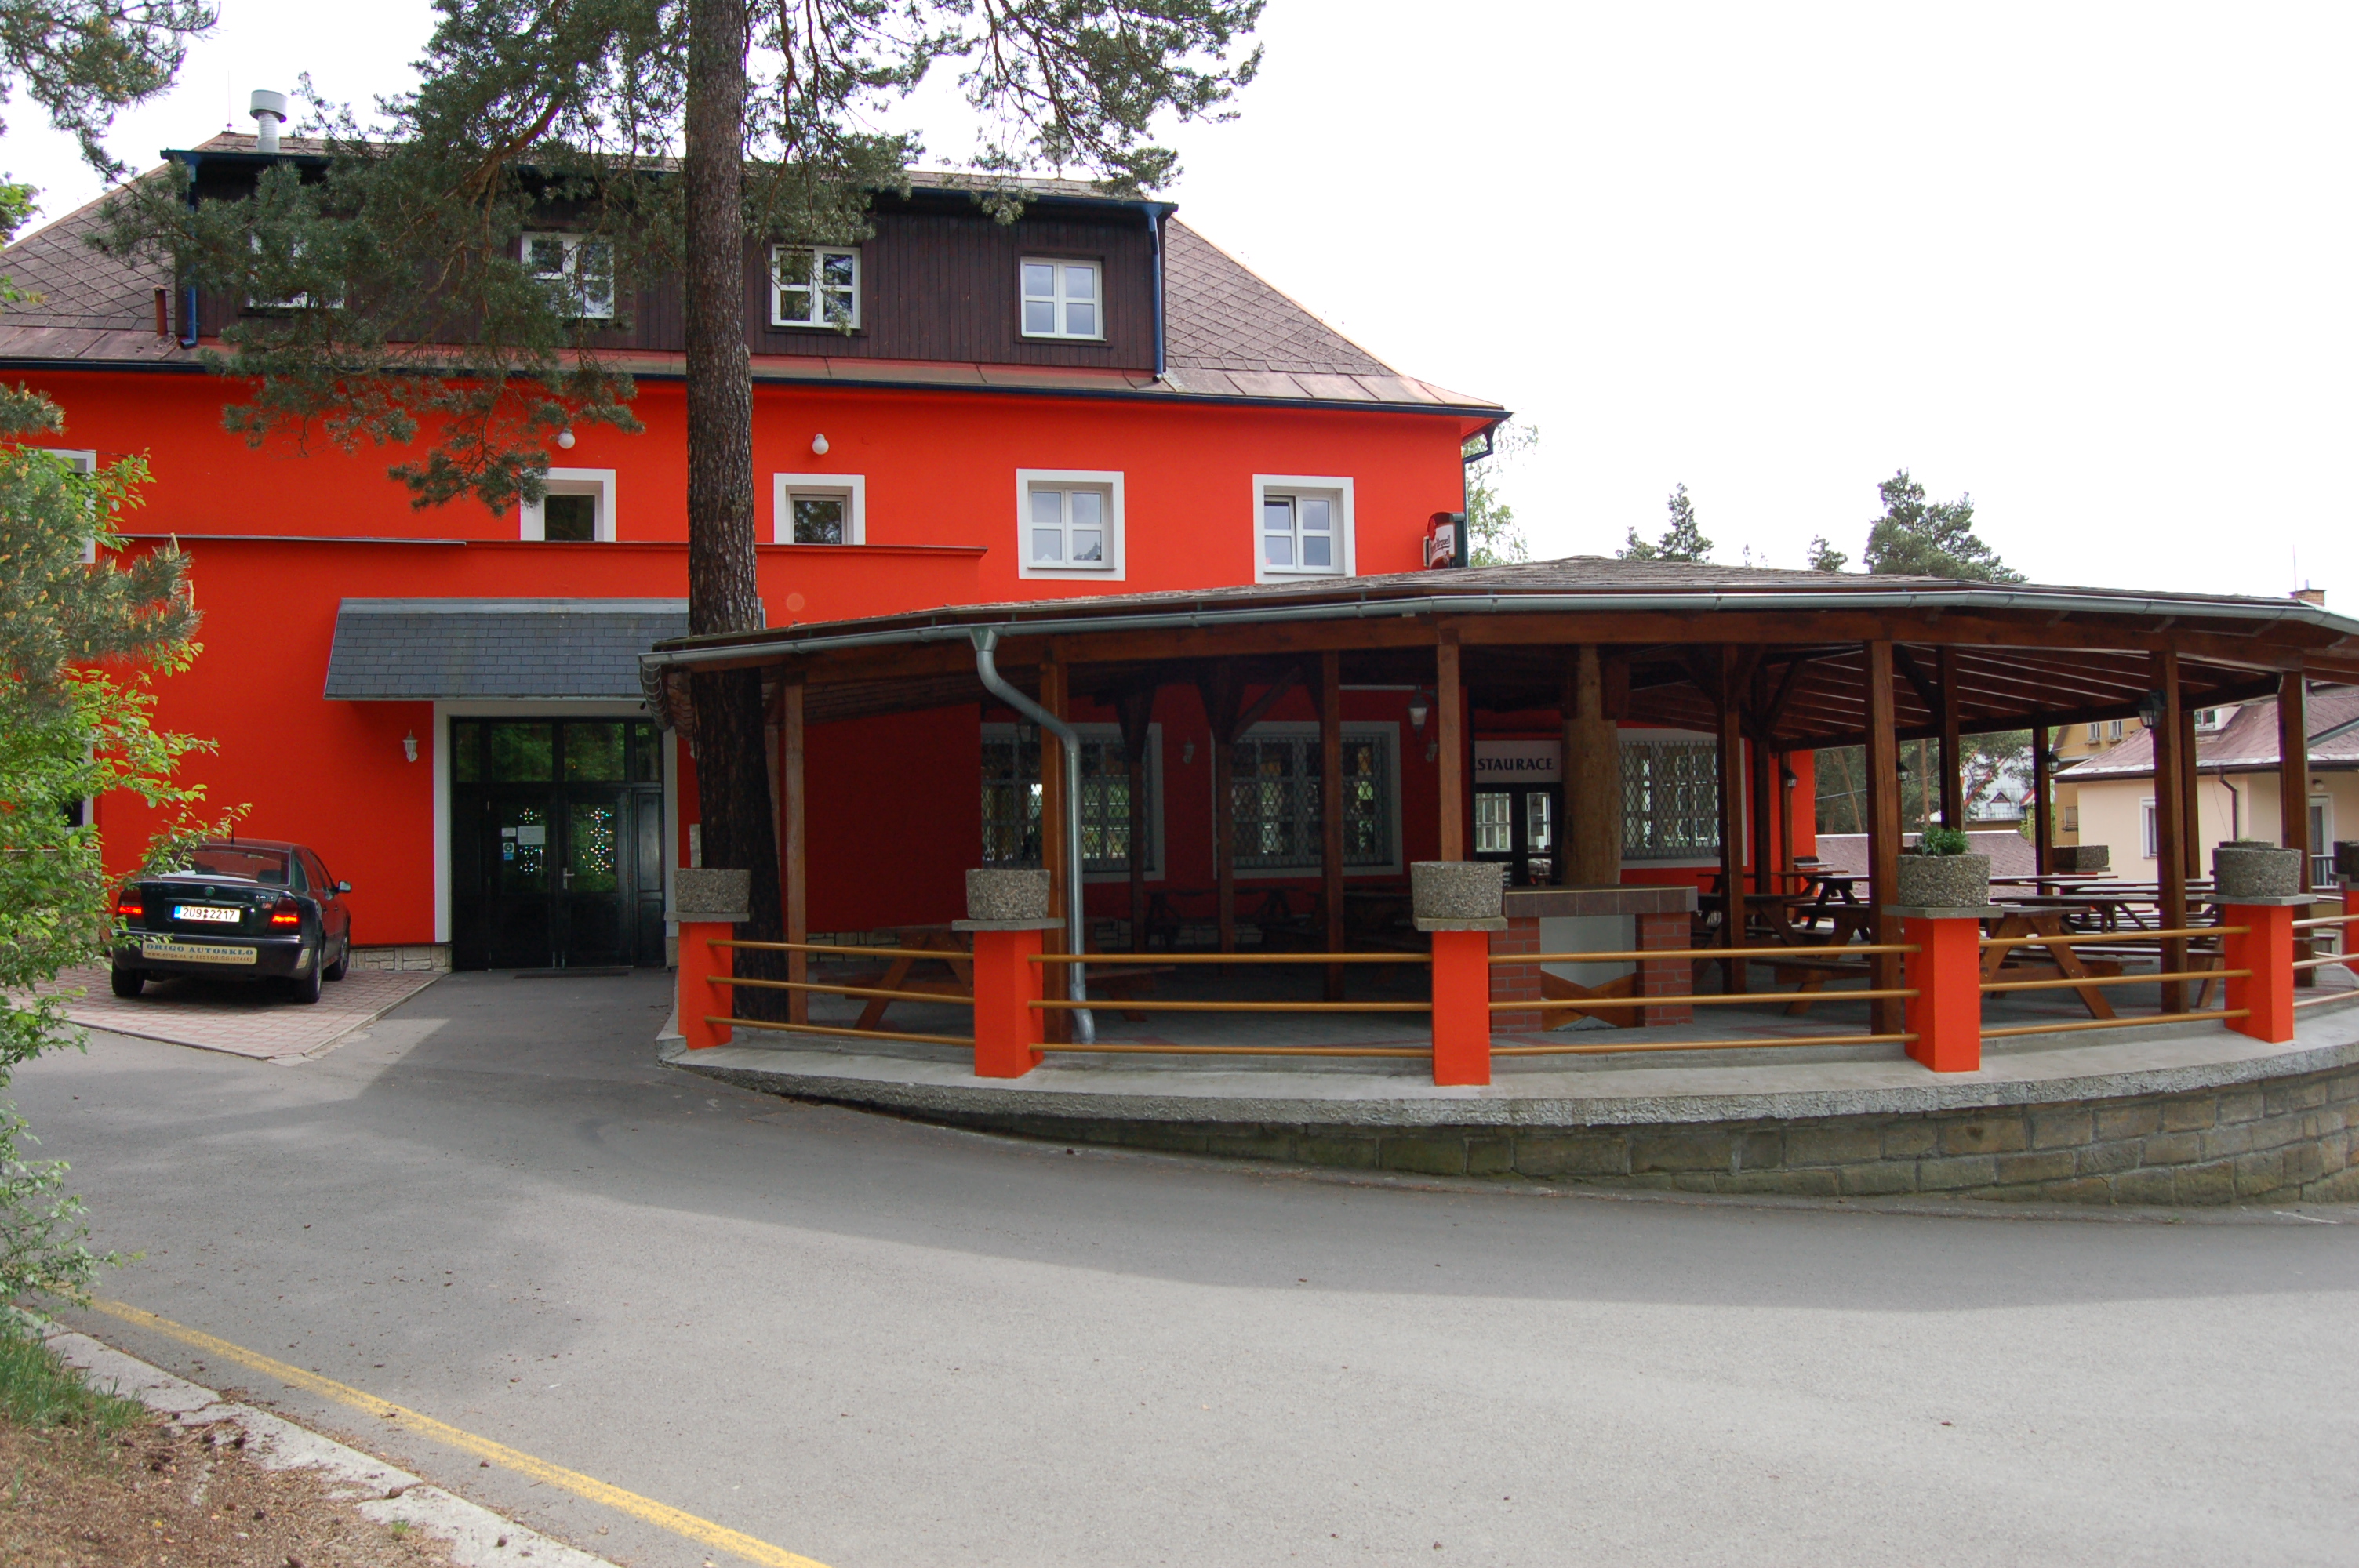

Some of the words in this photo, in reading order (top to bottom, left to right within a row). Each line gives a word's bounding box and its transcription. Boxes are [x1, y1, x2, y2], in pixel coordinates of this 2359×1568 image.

[1475, 757, 1554, 771] STAURACE
[183, 907, 202, 918] 2U9
[209, 909, 235, 920] 2217
[146, 943, 185, 953] ORIGO
[189, 946, 253, 956] AUTOSKLO
